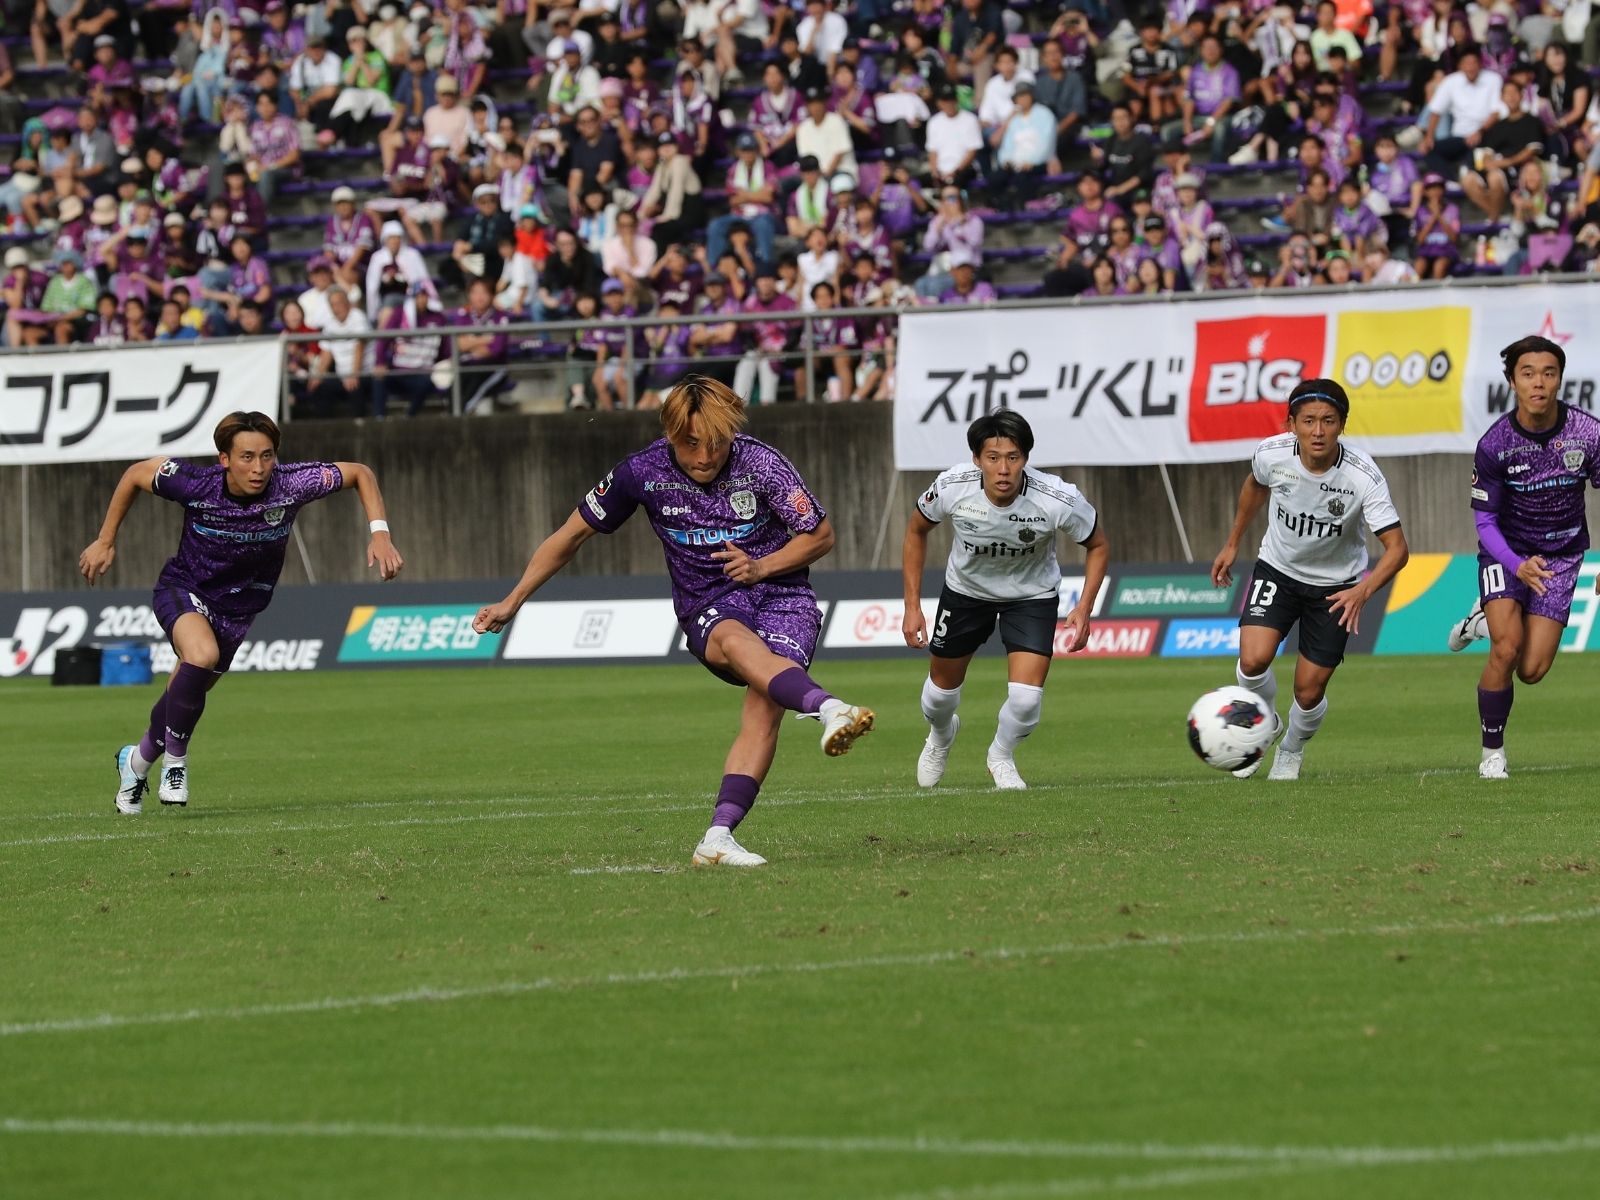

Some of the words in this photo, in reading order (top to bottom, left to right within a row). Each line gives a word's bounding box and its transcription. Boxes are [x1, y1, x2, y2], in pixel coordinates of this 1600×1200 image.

[0, 363, 219, 447] コワーク
[919, 350, 1183, 424] スポーツくじ
[1250, 579, 1278, 606] 13
[1482, 563, 1505, 596] 10
[367, 613, 484, 652] 明治安田
[936, 608, 951, 637] 5
